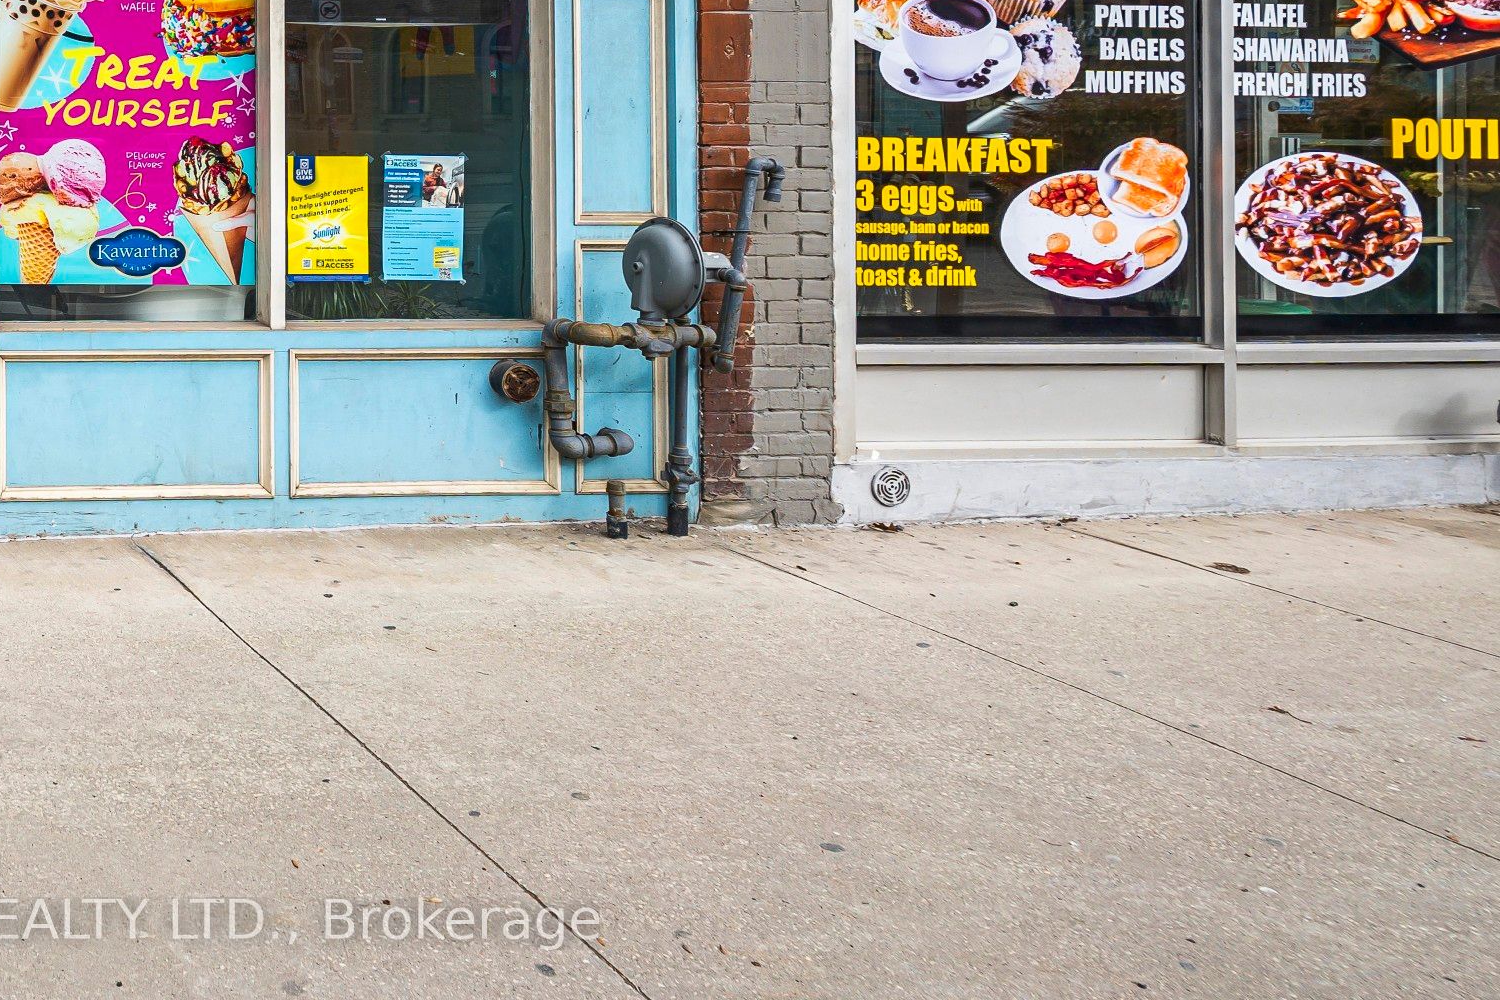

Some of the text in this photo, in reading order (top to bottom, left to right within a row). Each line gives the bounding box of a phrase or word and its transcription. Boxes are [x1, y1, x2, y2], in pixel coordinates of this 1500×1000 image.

[120, 2, 156, 12] WAFFLE
[1094, 4, 1185, 29] PATTIES
[1233, 2, 1308, 28] FALAFEL
[1099, 37, 1185, 62] BAGELS
[1233, 37, 1349, 63] SHAWARMA
[62, 46, 218, 91] TREAT
[1085, 70, 1186, 95] MUFFINS
[1233, 71, 1367, 98] FRENCH FRIES
[43, 98, 234, 128] YOURSELF
[1391, 117, 1499, 160] POUTI
[125, 151, 167, 160] DELICIOUS
[128, 161, 164, 169] FLAVORS
[857, 136, 1053, 173] BREAKFAST
[323, 197, 348, 207] support
[333, 186, 364, 196] detergent
[856, 179, 983, 215] 3 eggs with
[291, 210, 324, 219] Canadians
[312, 225, 341, 239] Sunlight
[856, 221, 990, 235] sausage, ham or bacon
[97, 243, 179, 261] Kawartha
[856, 240, 963, 264] home fries,
[856, 265, 977, 287] toast & drink
